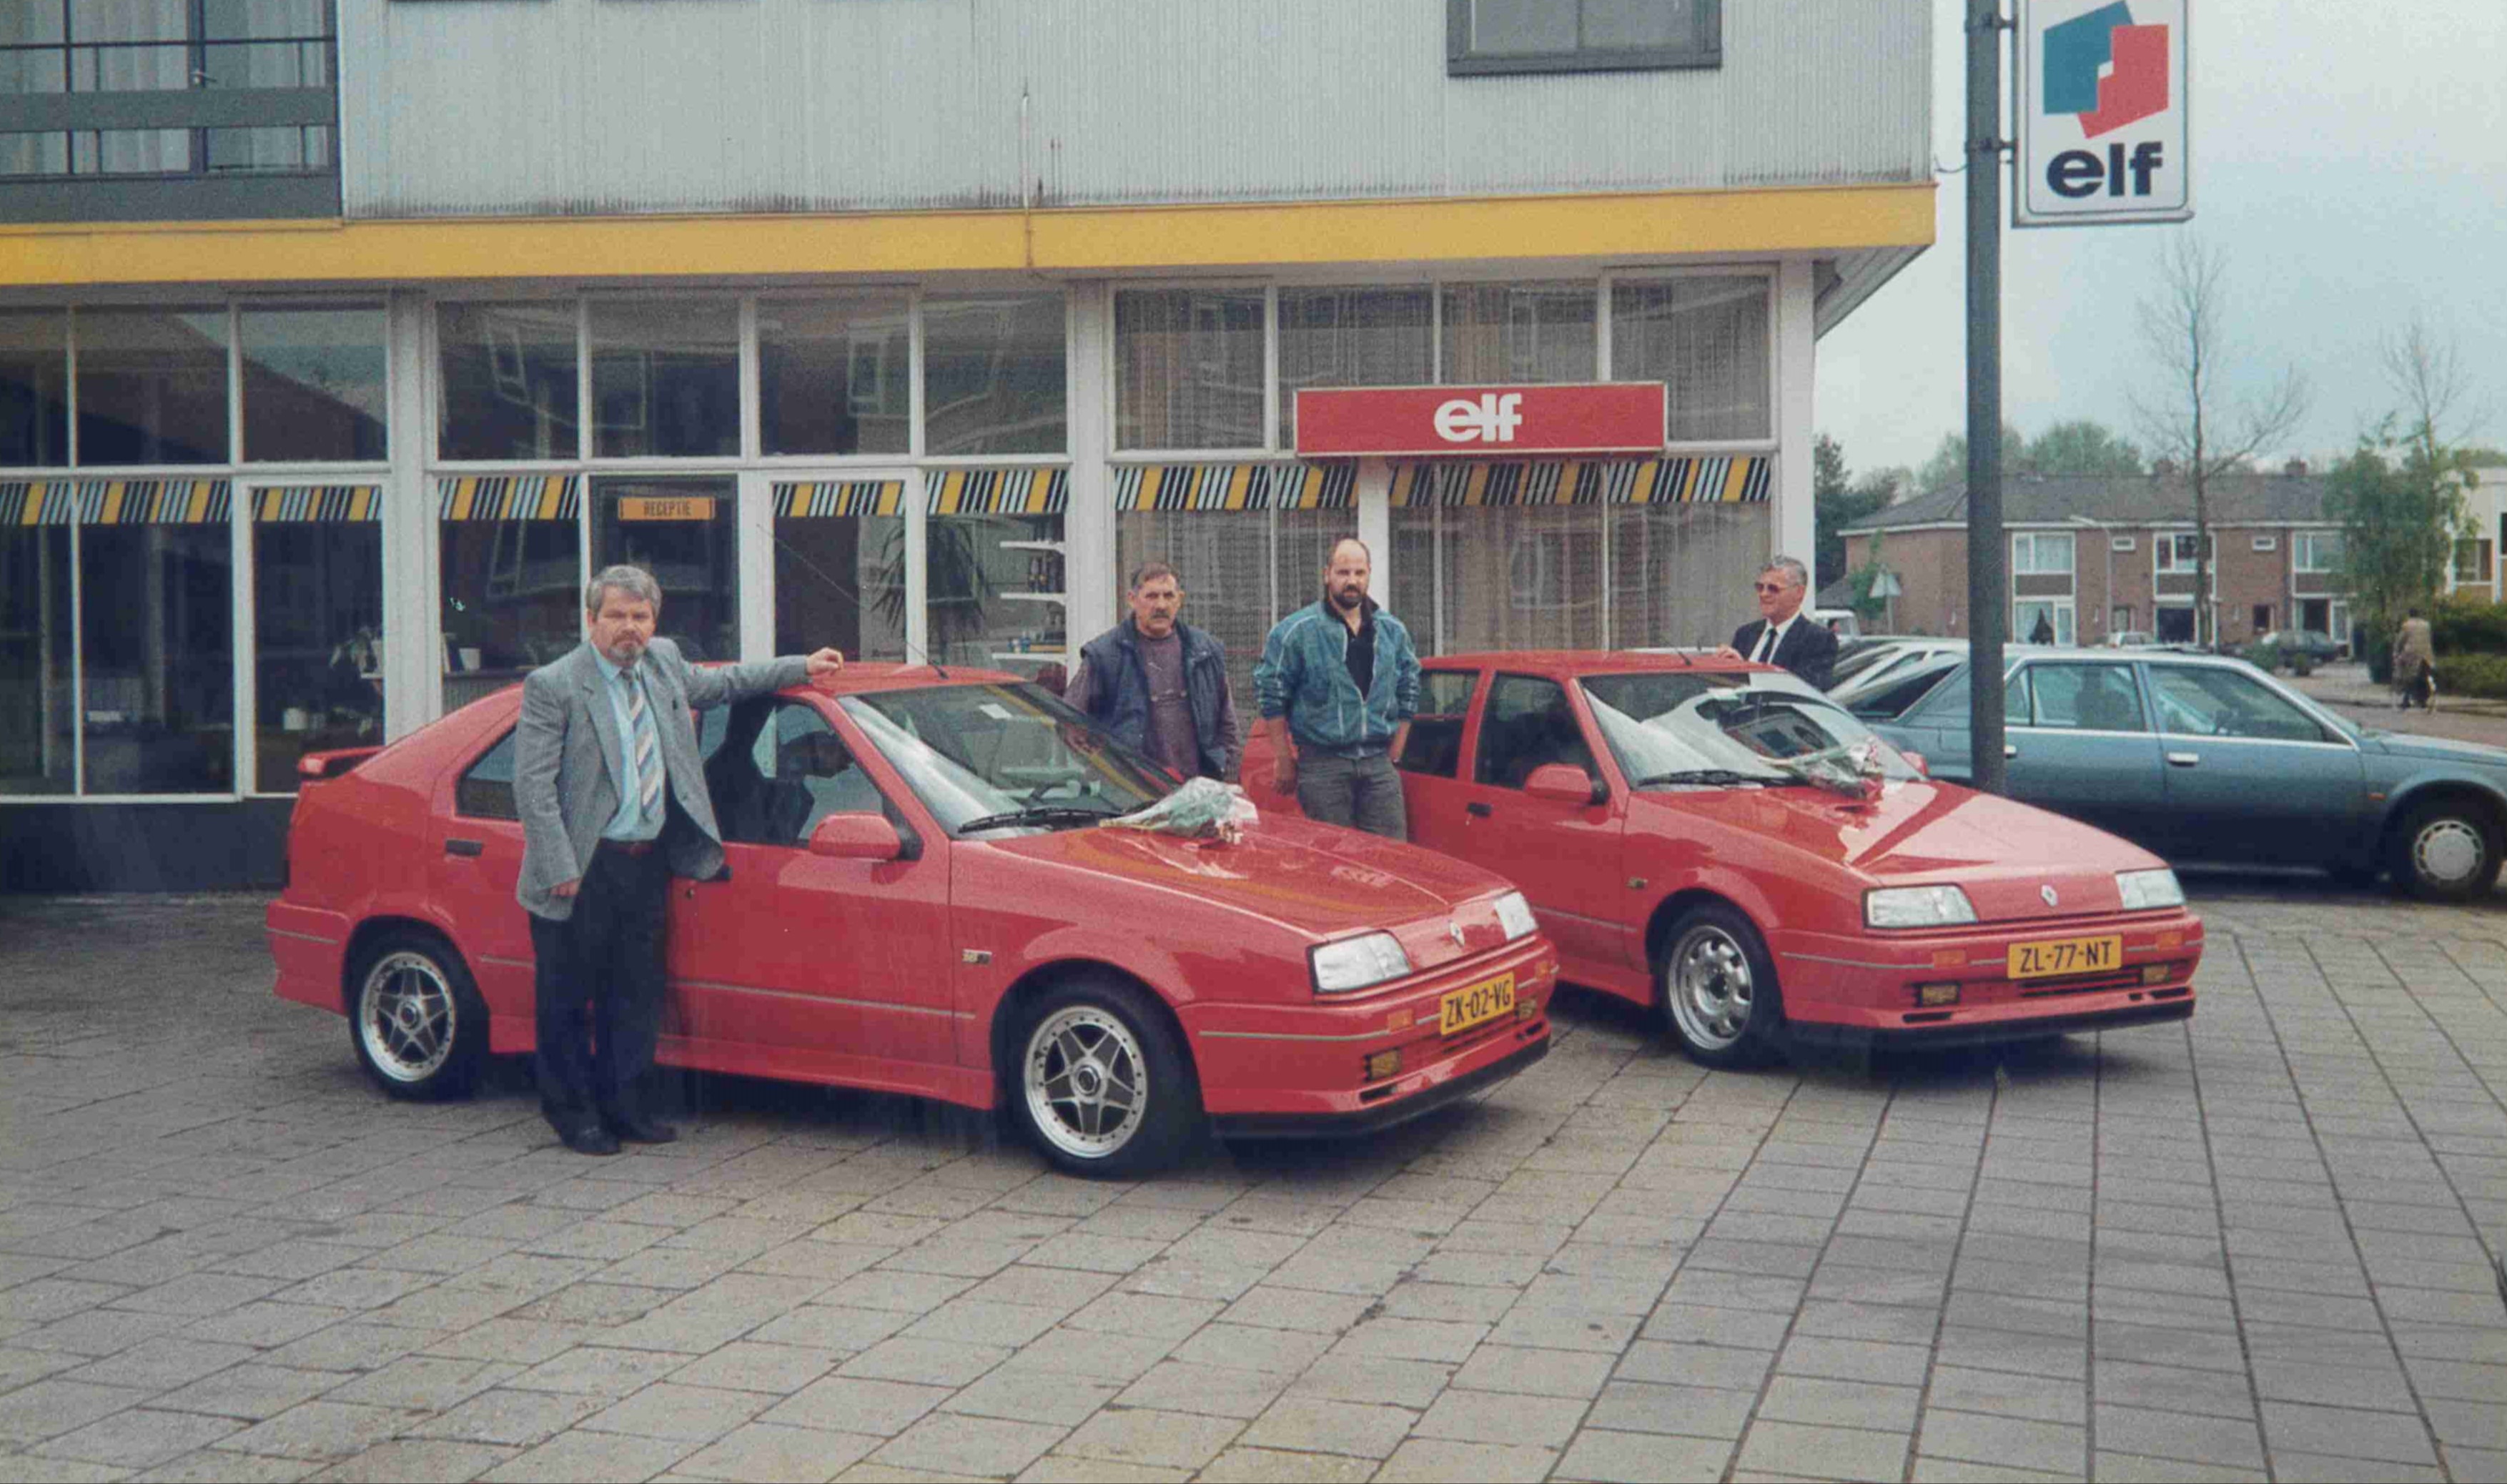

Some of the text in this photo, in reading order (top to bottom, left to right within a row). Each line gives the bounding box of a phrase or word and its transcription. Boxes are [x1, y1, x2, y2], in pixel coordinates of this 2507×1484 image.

[2047, 142, 2162, 198] elf
[1434, 393, 1522, 442] elf
[643, 500, 691, 517] RECEPTIE
[2019, 941, 2112, 973] ZL-77-NT
[1445, 979, 1510, 1028] ZK-02-VG
